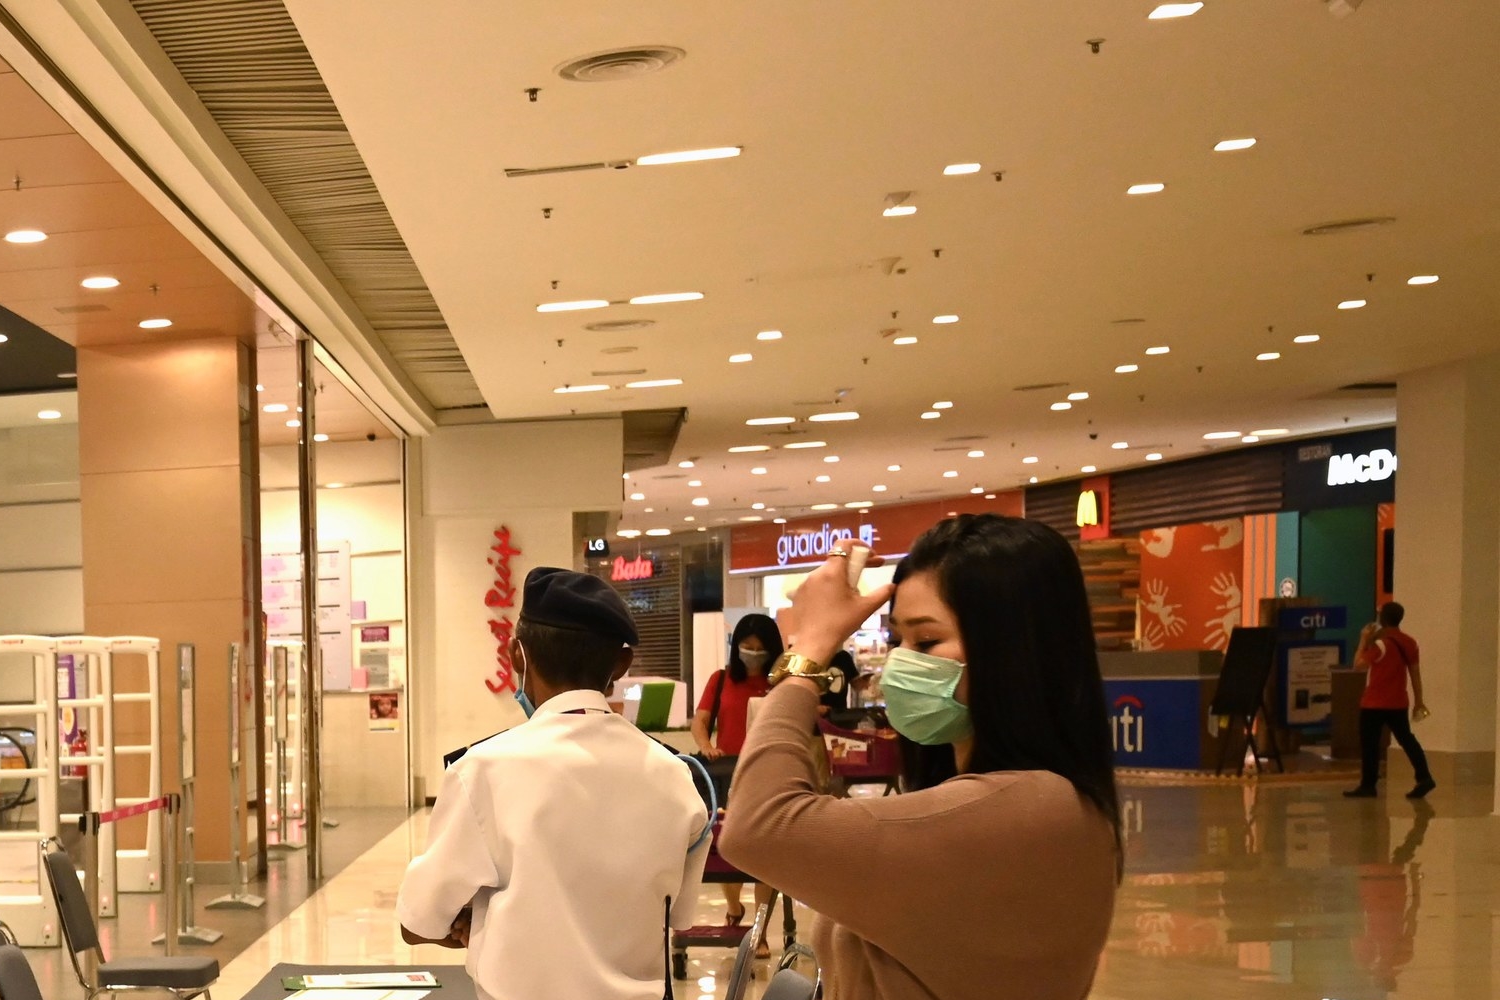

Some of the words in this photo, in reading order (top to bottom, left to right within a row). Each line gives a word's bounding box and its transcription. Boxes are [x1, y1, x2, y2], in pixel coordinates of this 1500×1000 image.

[588, 538, 605, 551] LG
[611, 555, 655, 582] Bata
[1300, 613, 1327, 628] citi
